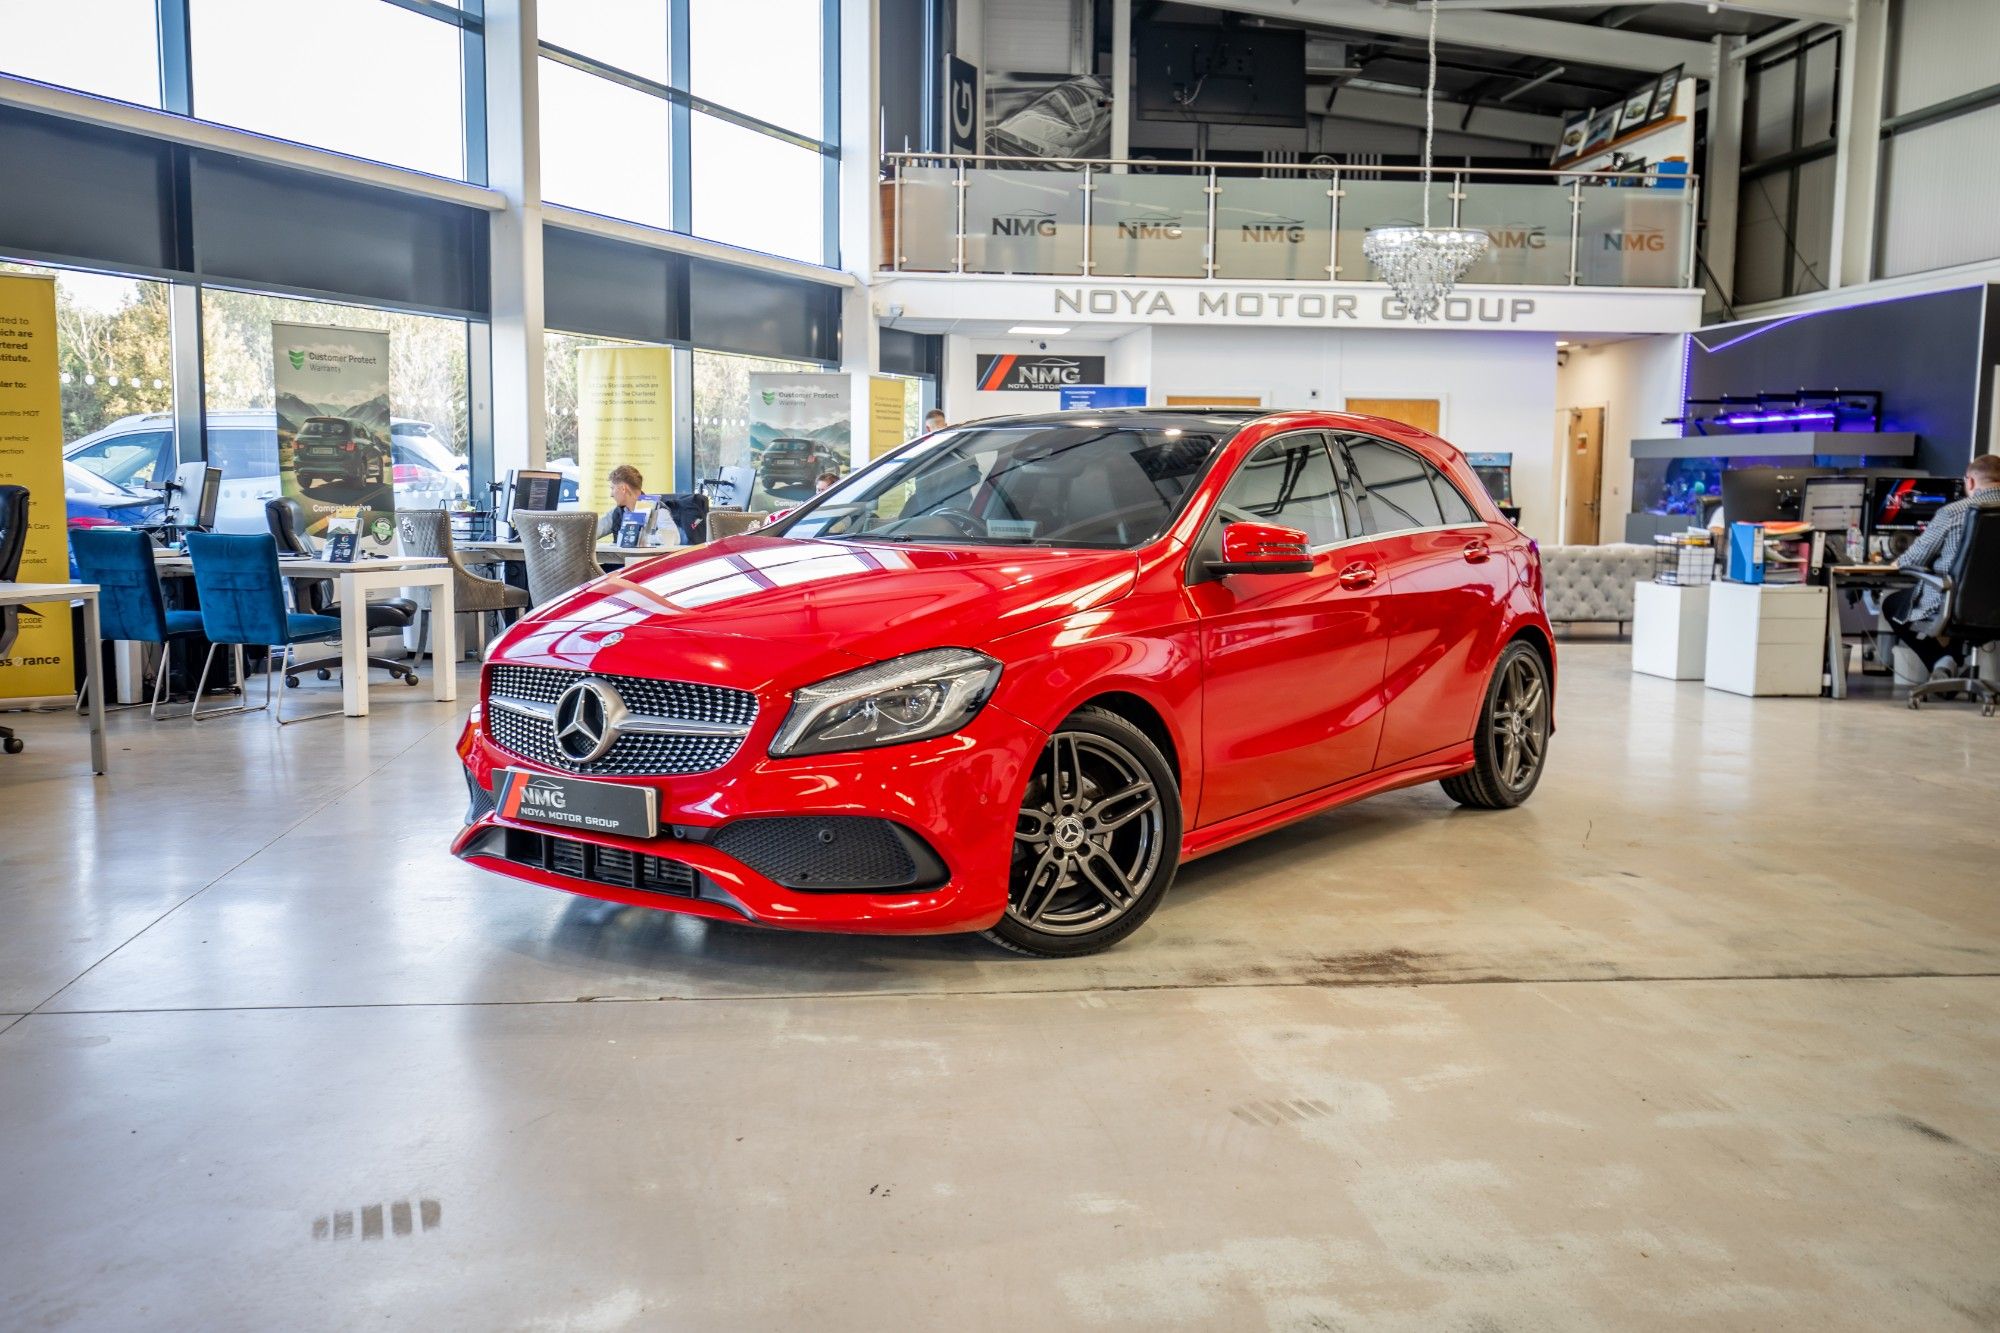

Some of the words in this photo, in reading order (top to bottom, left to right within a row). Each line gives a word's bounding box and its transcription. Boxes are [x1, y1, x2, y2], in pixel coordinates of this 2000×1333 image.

[992, 218, 1056, 236] NMG
[1118, 221, 1182, 240] NMG
[1241, 225, 1305, 243] NMG
[1604, 233, 1665, 251] NMG
[1055, 289, 1175, 315] NOYA
[1198, 291, 1358, 319] MOTOR
[18, 330, 33, 338] are
[308, 352, 346, 362] Customer
[348, 355, 377, 365] Protect
[309, 364, 341, 374] Warranty
[1018, 366, 1081, 384] NMG
[519, 786, 567, 809] NMG
[520, 807, 546, 818] NOYA
[548, 811, 583, 823] MOTOR
[585, 816, 620, 829] GROUP
